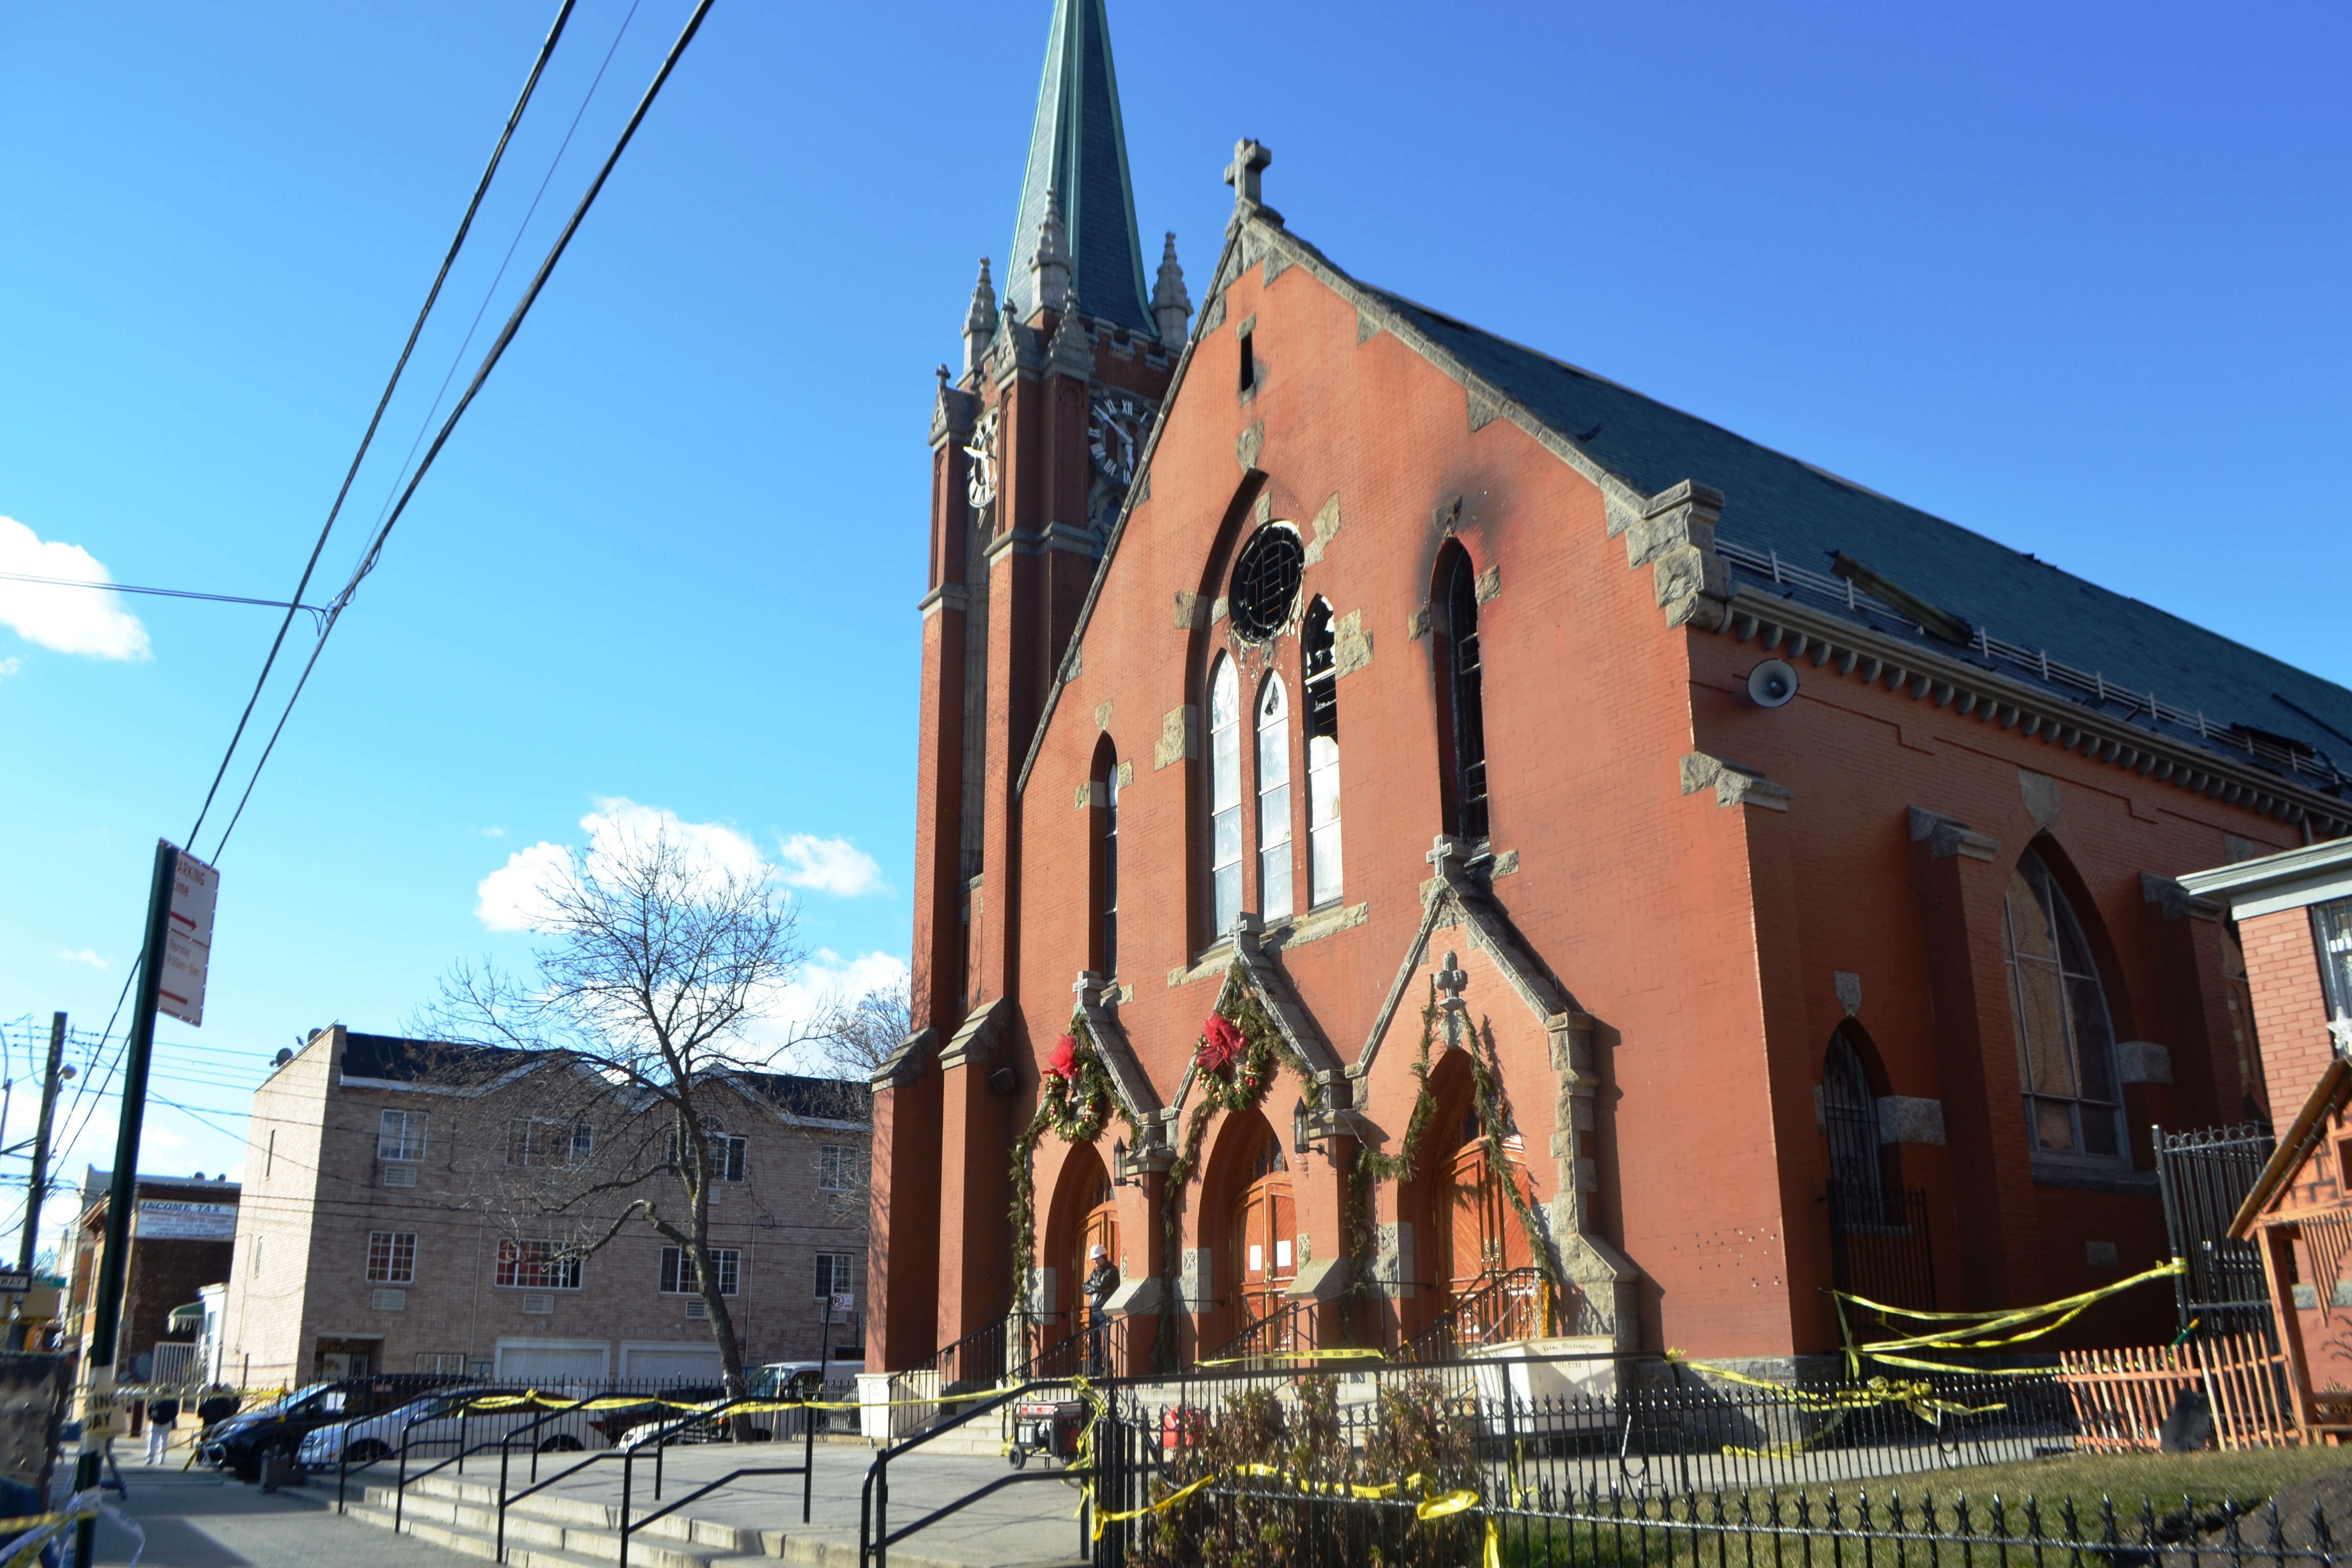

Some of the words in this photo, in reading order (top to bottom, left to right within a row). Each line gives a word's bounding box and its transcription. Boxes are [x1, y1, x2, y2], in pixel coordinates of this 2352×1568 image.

[1122, 399, 1133, 416] XII
[140, 1202, 193, 1212] INCOME
[1, 1277, 23, 1287] WAY
